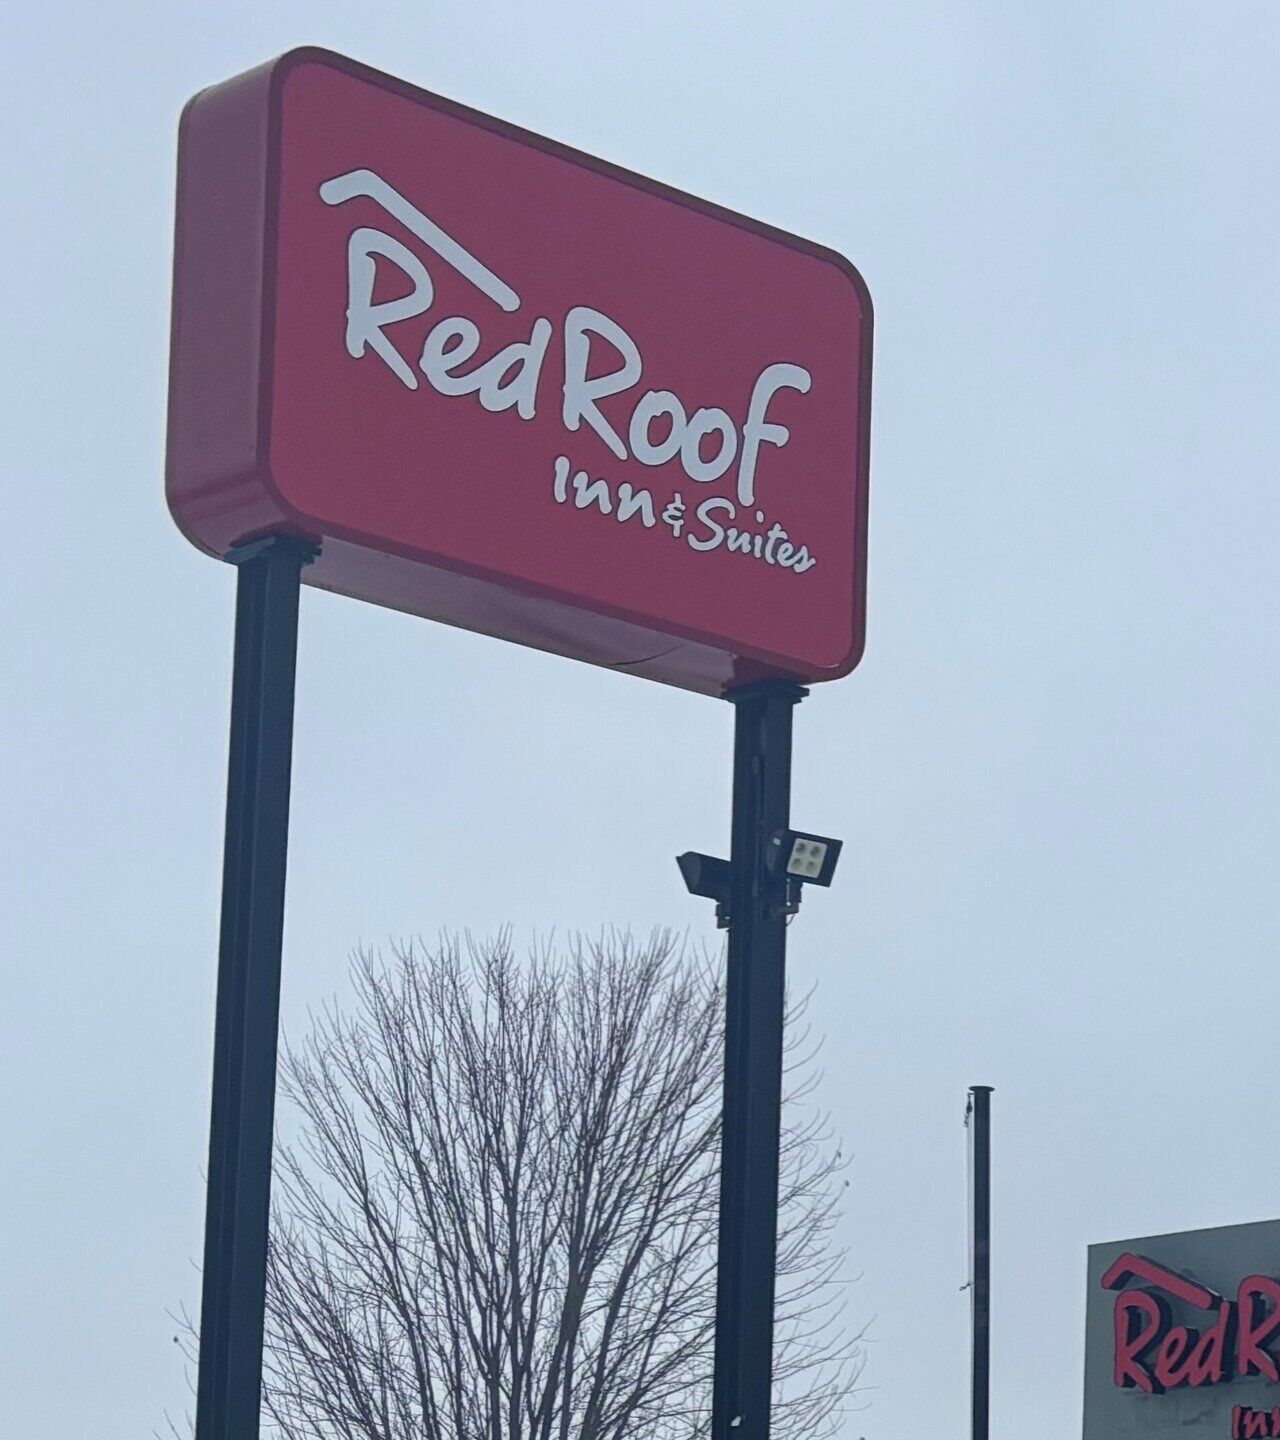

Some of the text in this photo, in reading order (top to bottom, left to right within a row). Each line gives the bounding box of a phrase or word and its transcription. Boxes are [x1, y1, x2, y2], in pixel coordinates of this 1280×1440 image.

[554, 456, 816, 573] Inn & Suites
